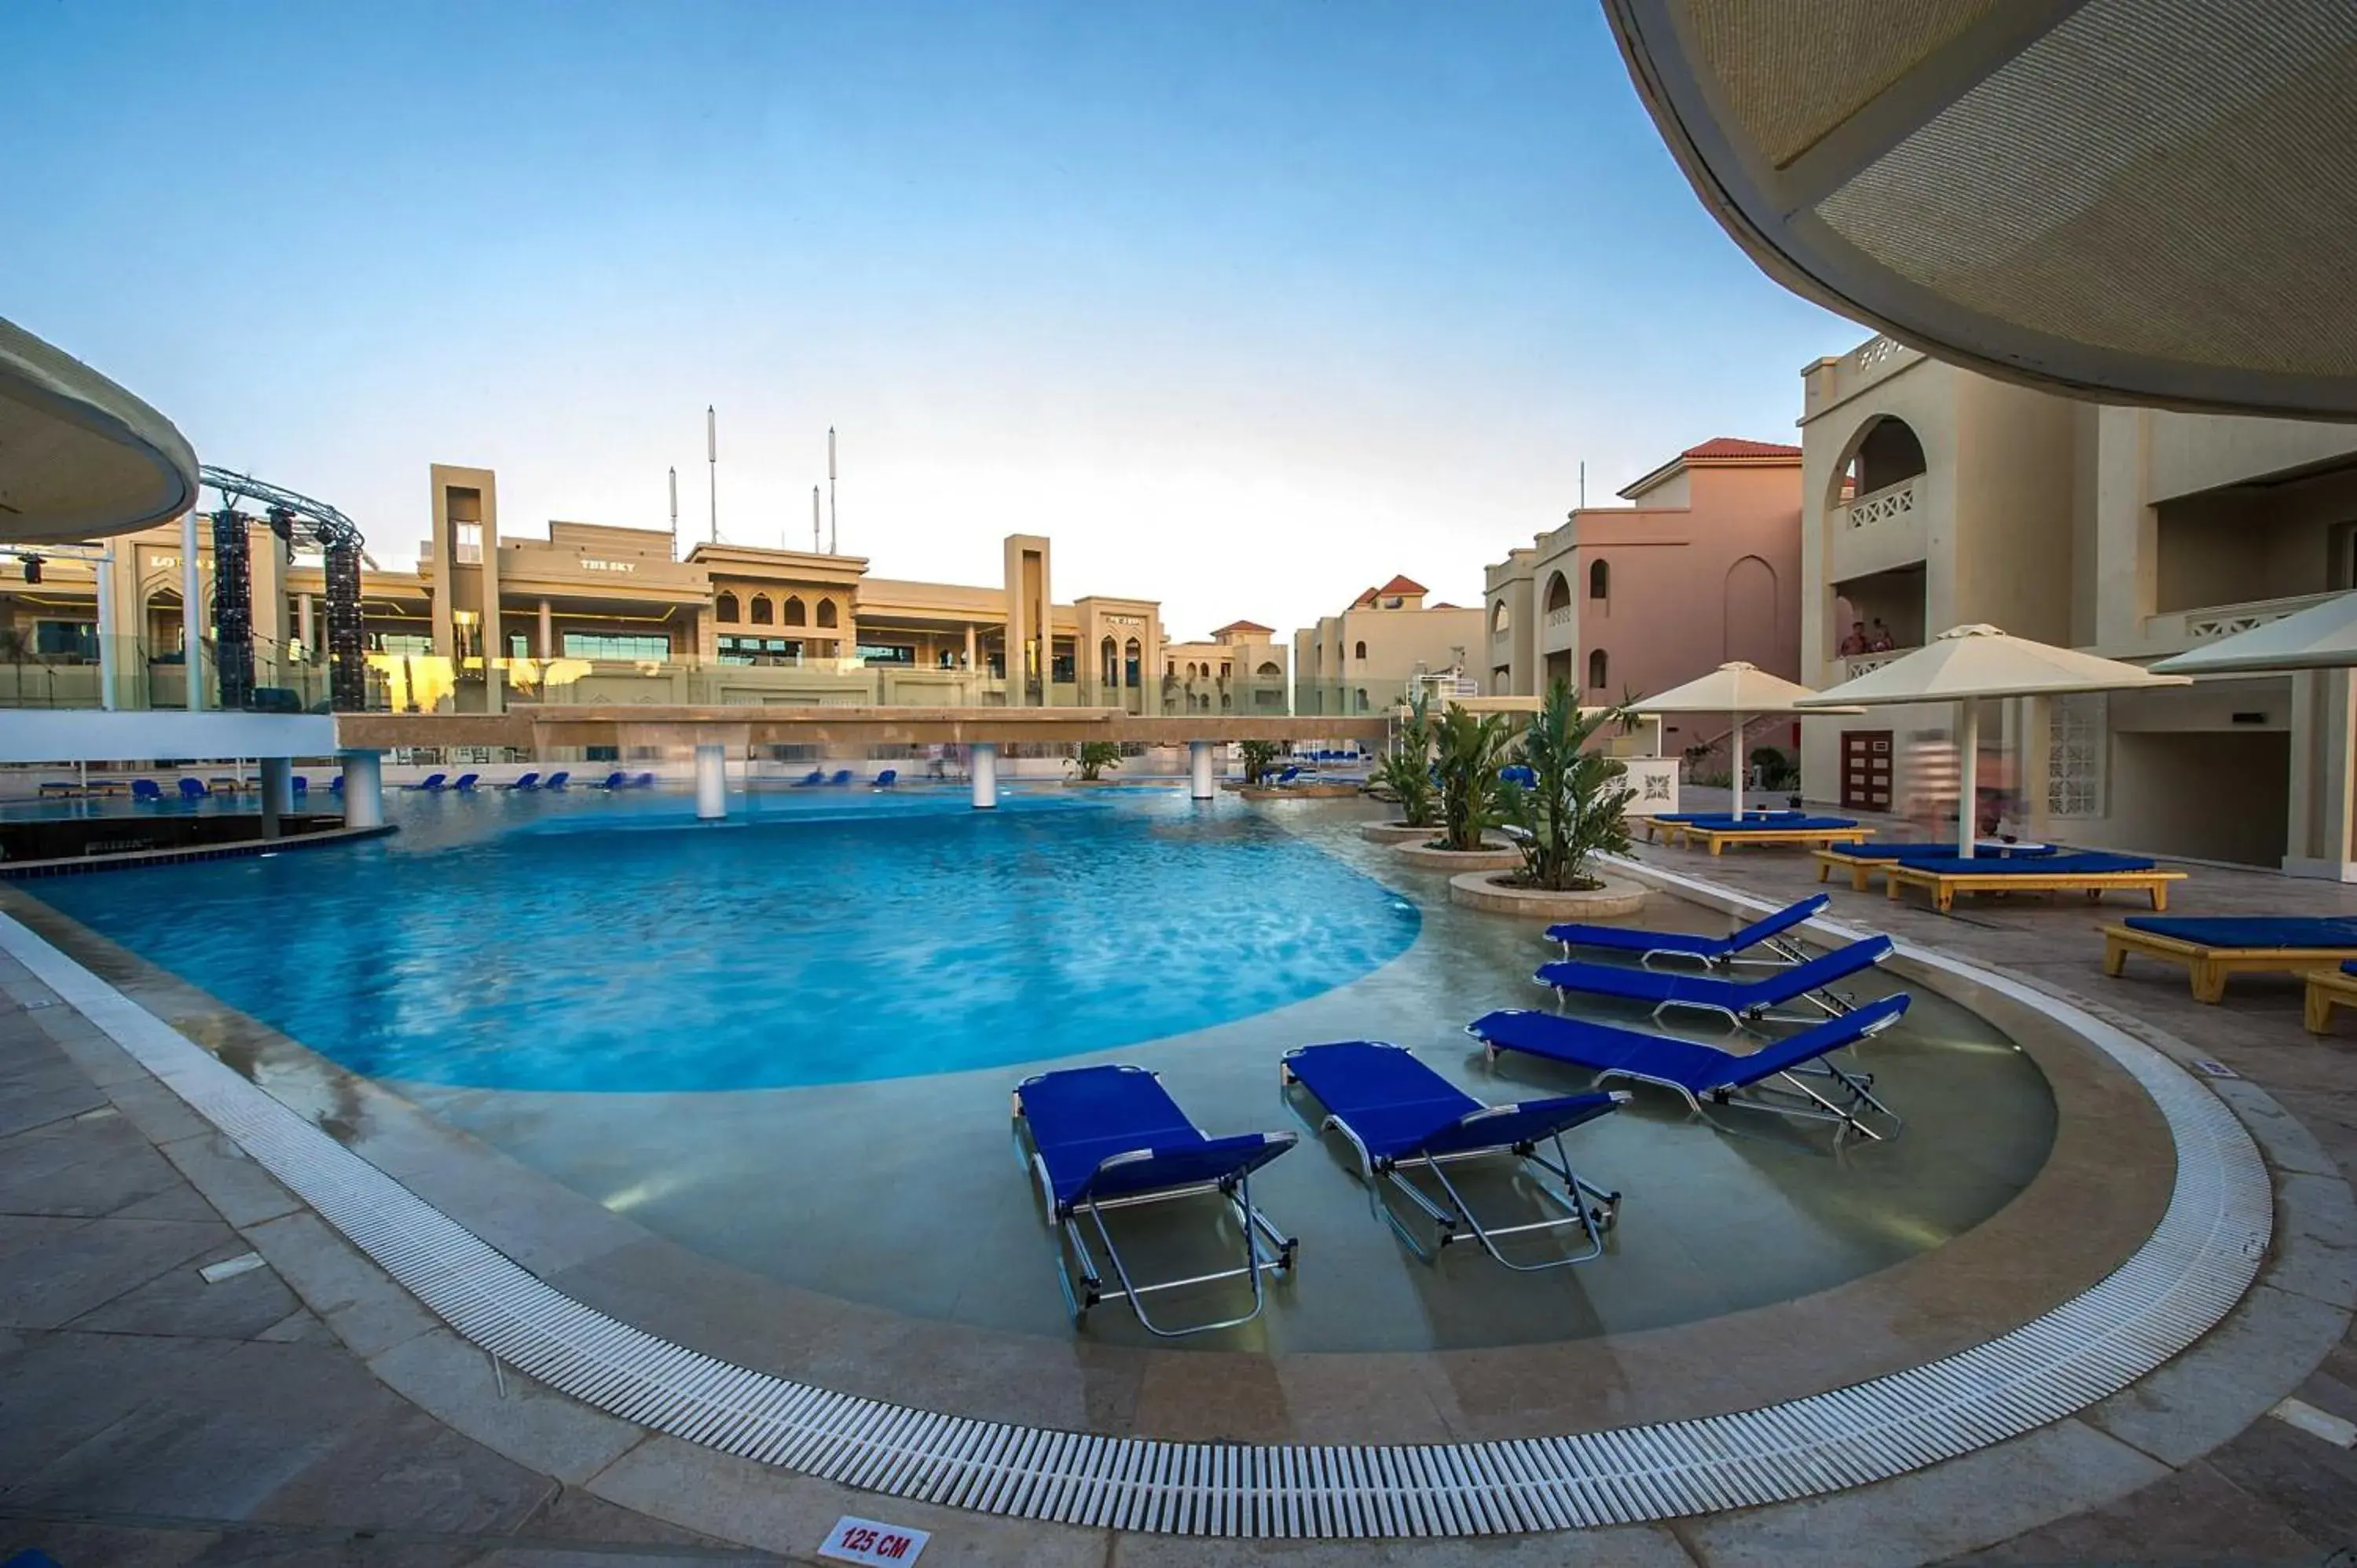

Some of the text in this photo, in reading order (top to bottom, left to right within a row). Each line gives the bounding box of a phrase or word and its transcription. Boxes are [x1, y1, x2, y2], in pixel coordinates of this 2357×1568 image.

[580, 559, 636, 572] THE SKY
[841, 1526, 911, 1559] 125 CM
